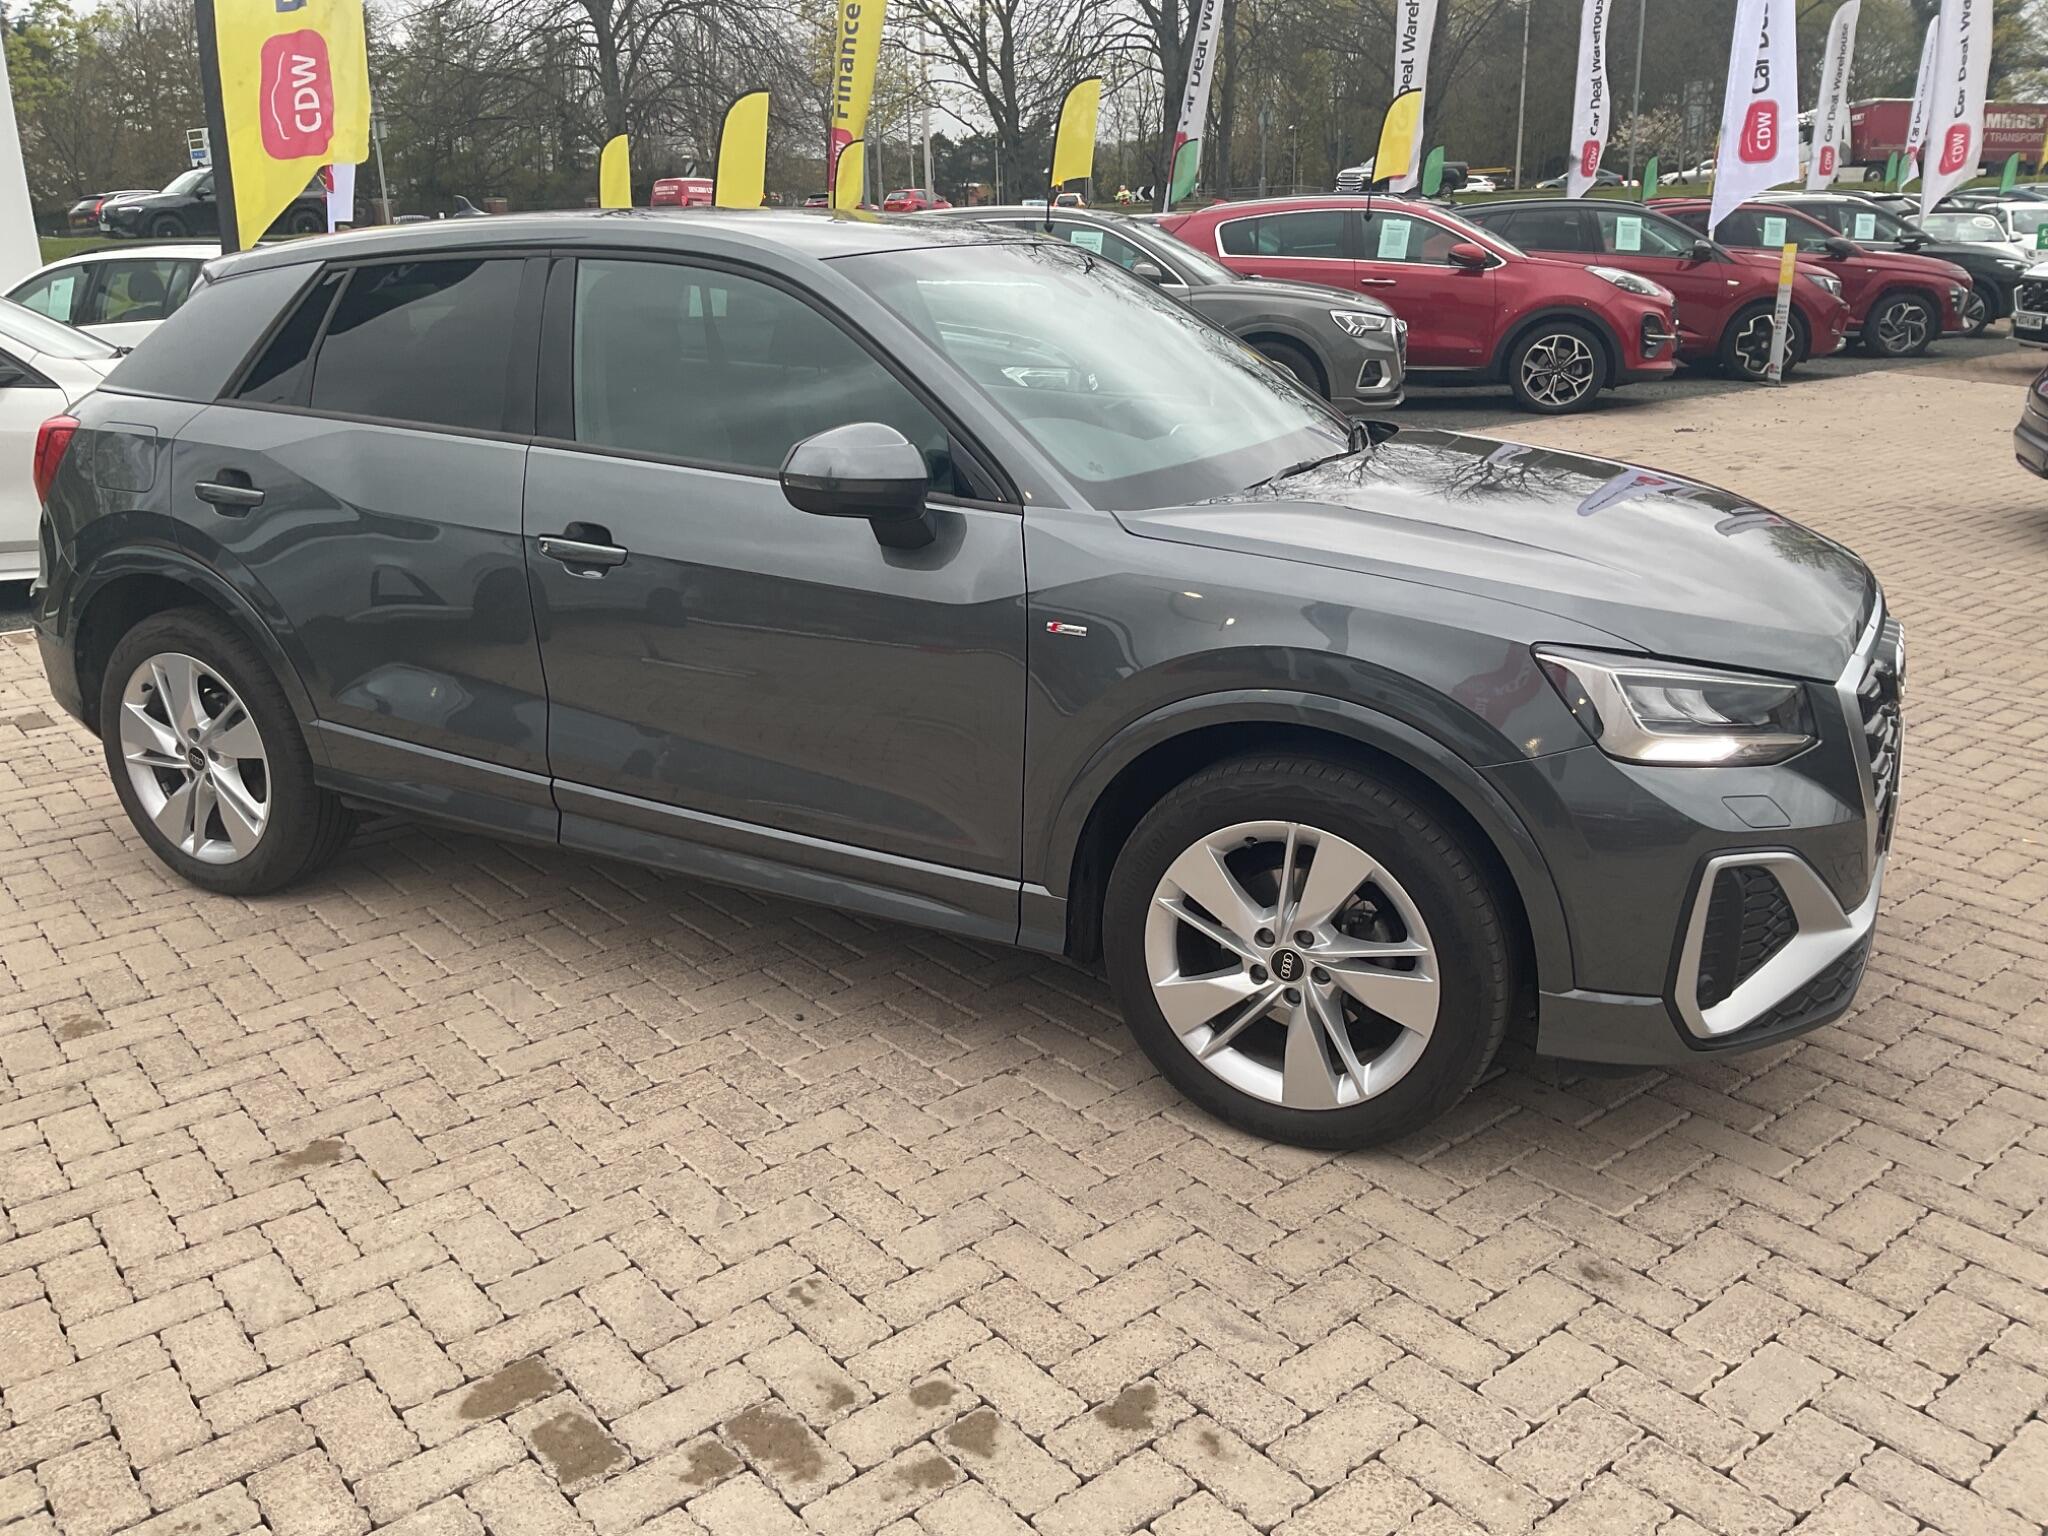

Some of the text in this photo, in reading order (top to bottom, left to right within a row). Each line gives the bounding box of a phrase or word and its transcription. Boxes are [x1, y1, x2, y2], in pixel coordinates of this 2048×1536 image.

[1958, 35, 1969, 82] Deal
[291, 54, 322, 133] CDW
[1590, 76, 1602, 110] Deal
[1824, 23, 1849, 143] Car Deal Warehouse
[1954, 88, 1966, 118] Car
[1590, 112, 1600, 136] Car
[1756, 111, 1772, 150] CDW
[1990, 132, 2045, 143] TRANSPORT
[1587, 147, 1598, 171] CDW
[1824, 151, 1833, 171] CDW
[1952, 133, 1966, 163] CDW
